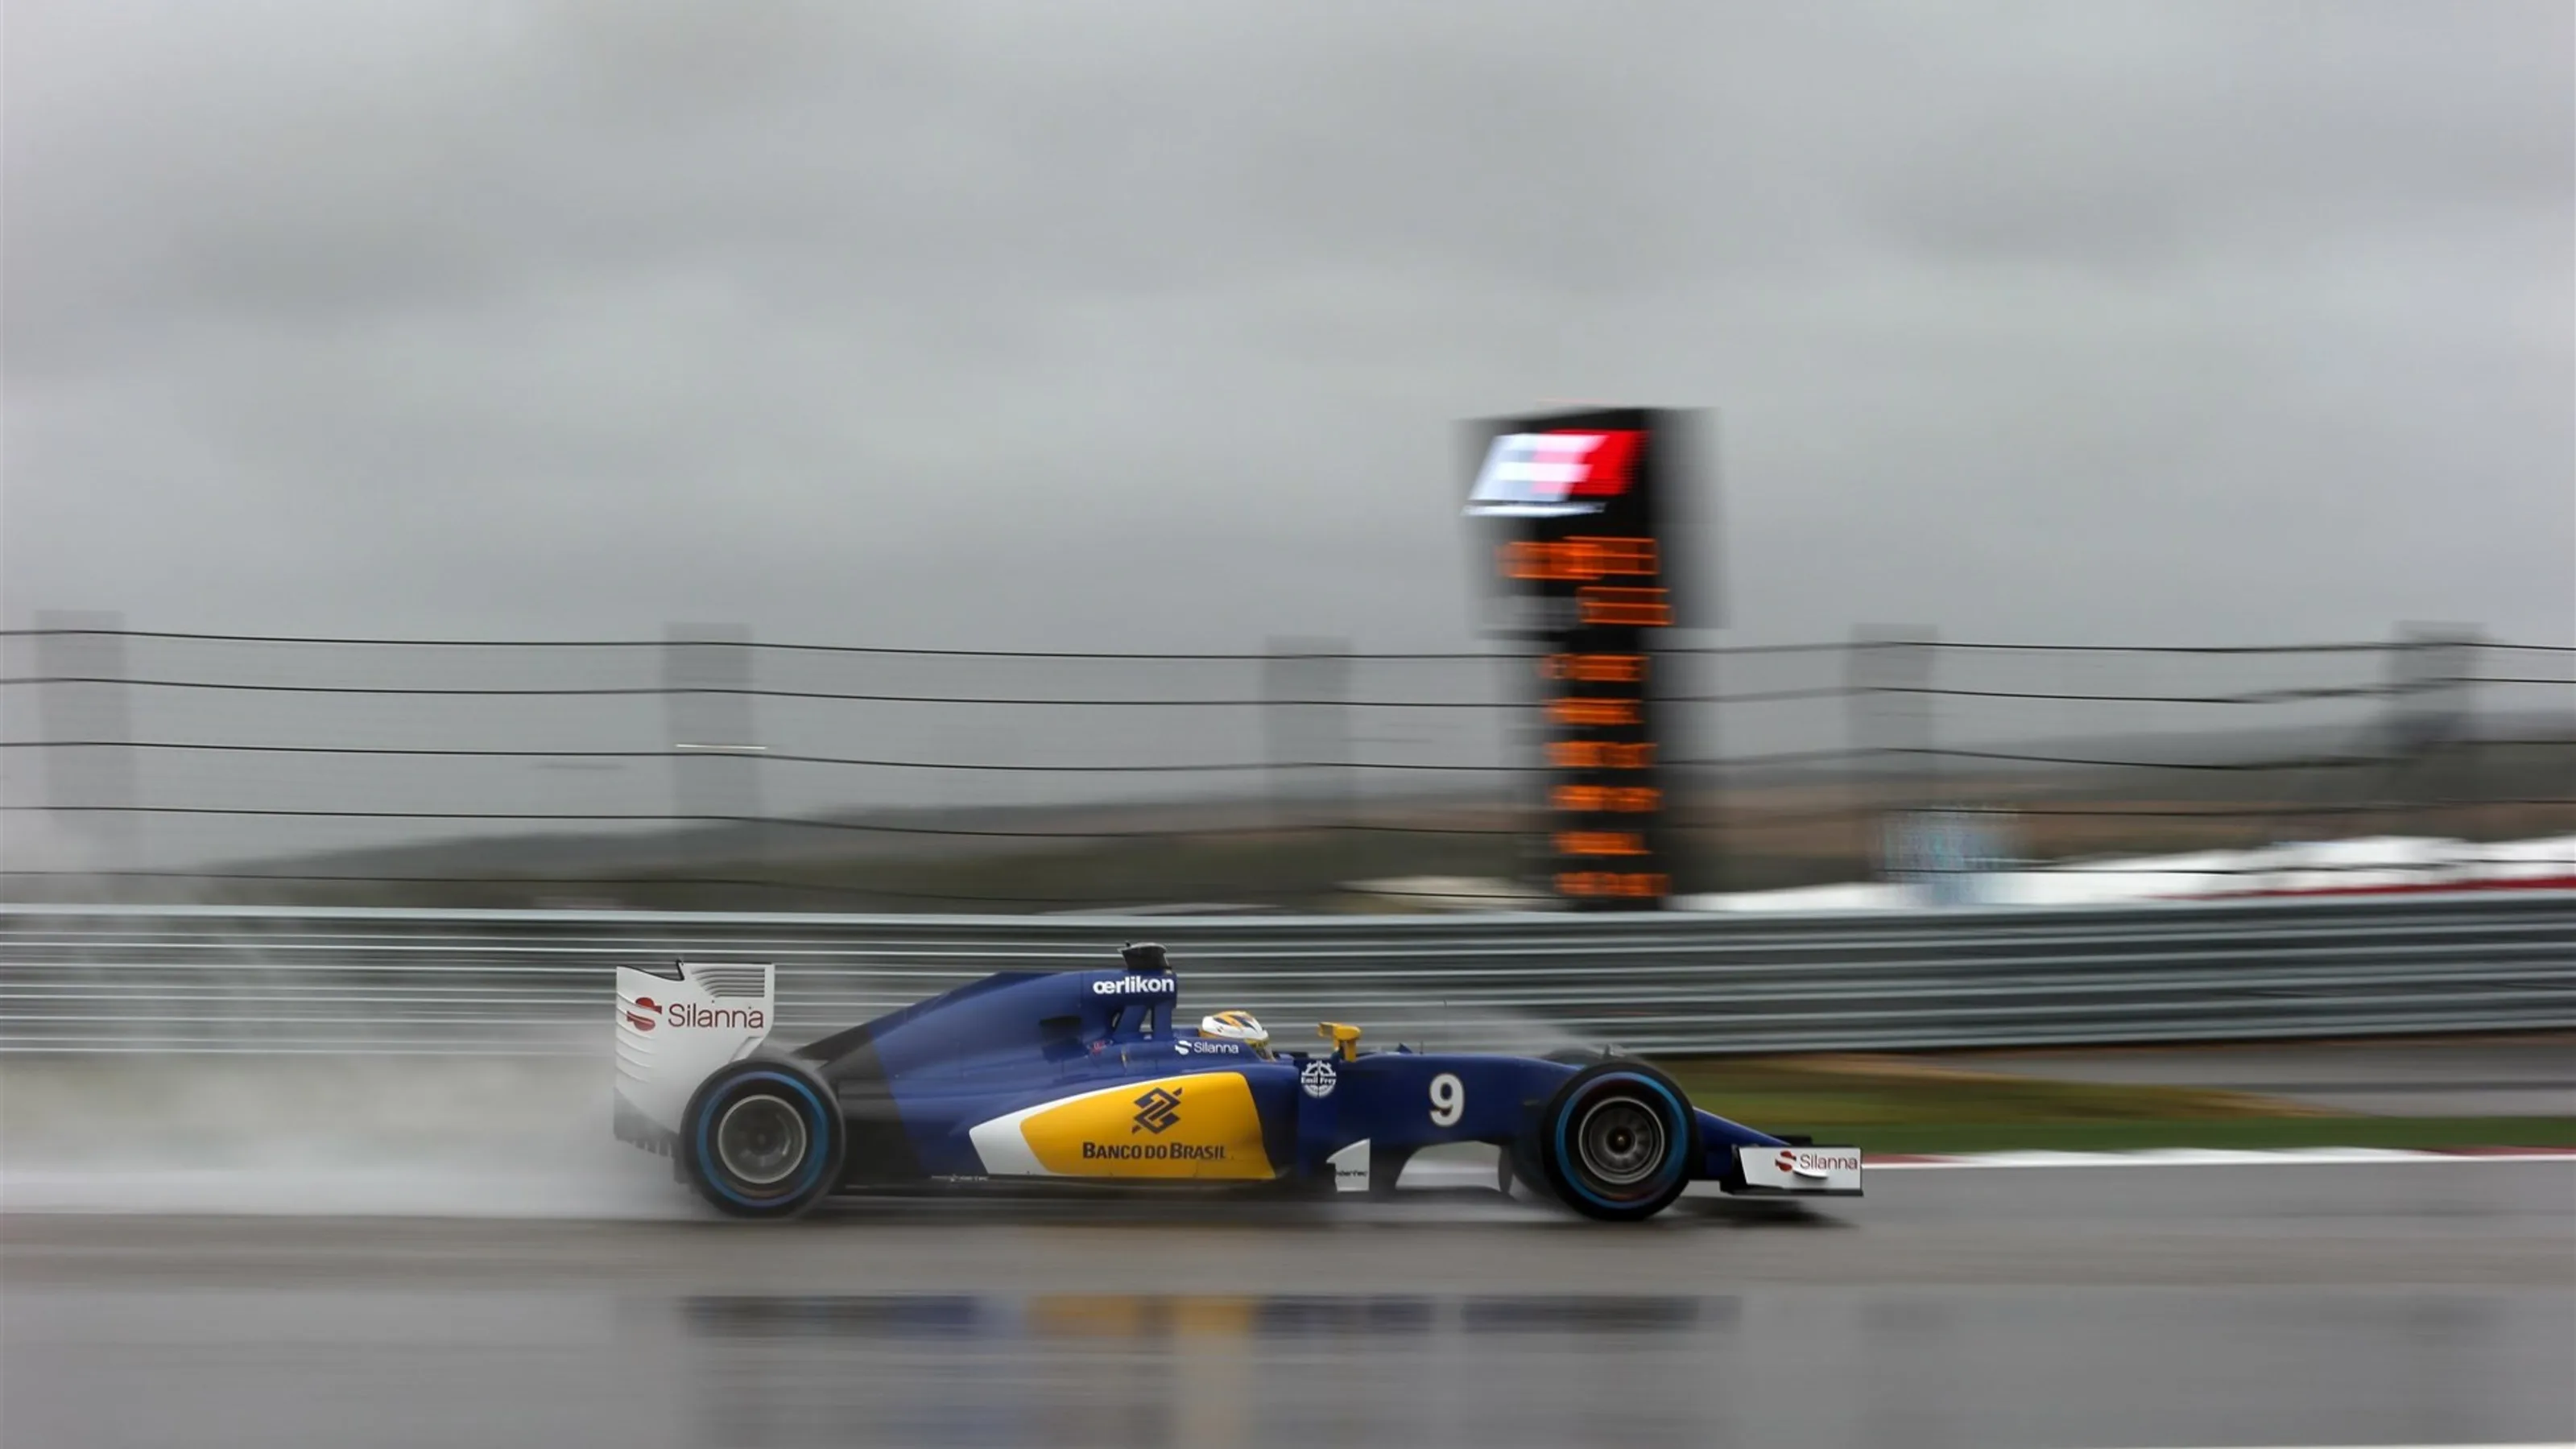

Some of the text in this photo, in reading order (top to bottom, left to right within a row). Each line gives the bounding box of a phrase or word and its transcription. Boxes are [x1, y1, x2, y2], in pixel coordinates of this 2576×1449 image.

[668, 1003, 764, 1029] Silanna
[1193, 1041, 1240, 1055] Silanna
[1300, 1076, 1337, 1086] Emil Frey
[1429, 1072, 1466, 1128] 9
[1082, 1141, 1226, 1160] BANCO DO BRASIL
[1800, 1153, 1859, 1170] Silanna
